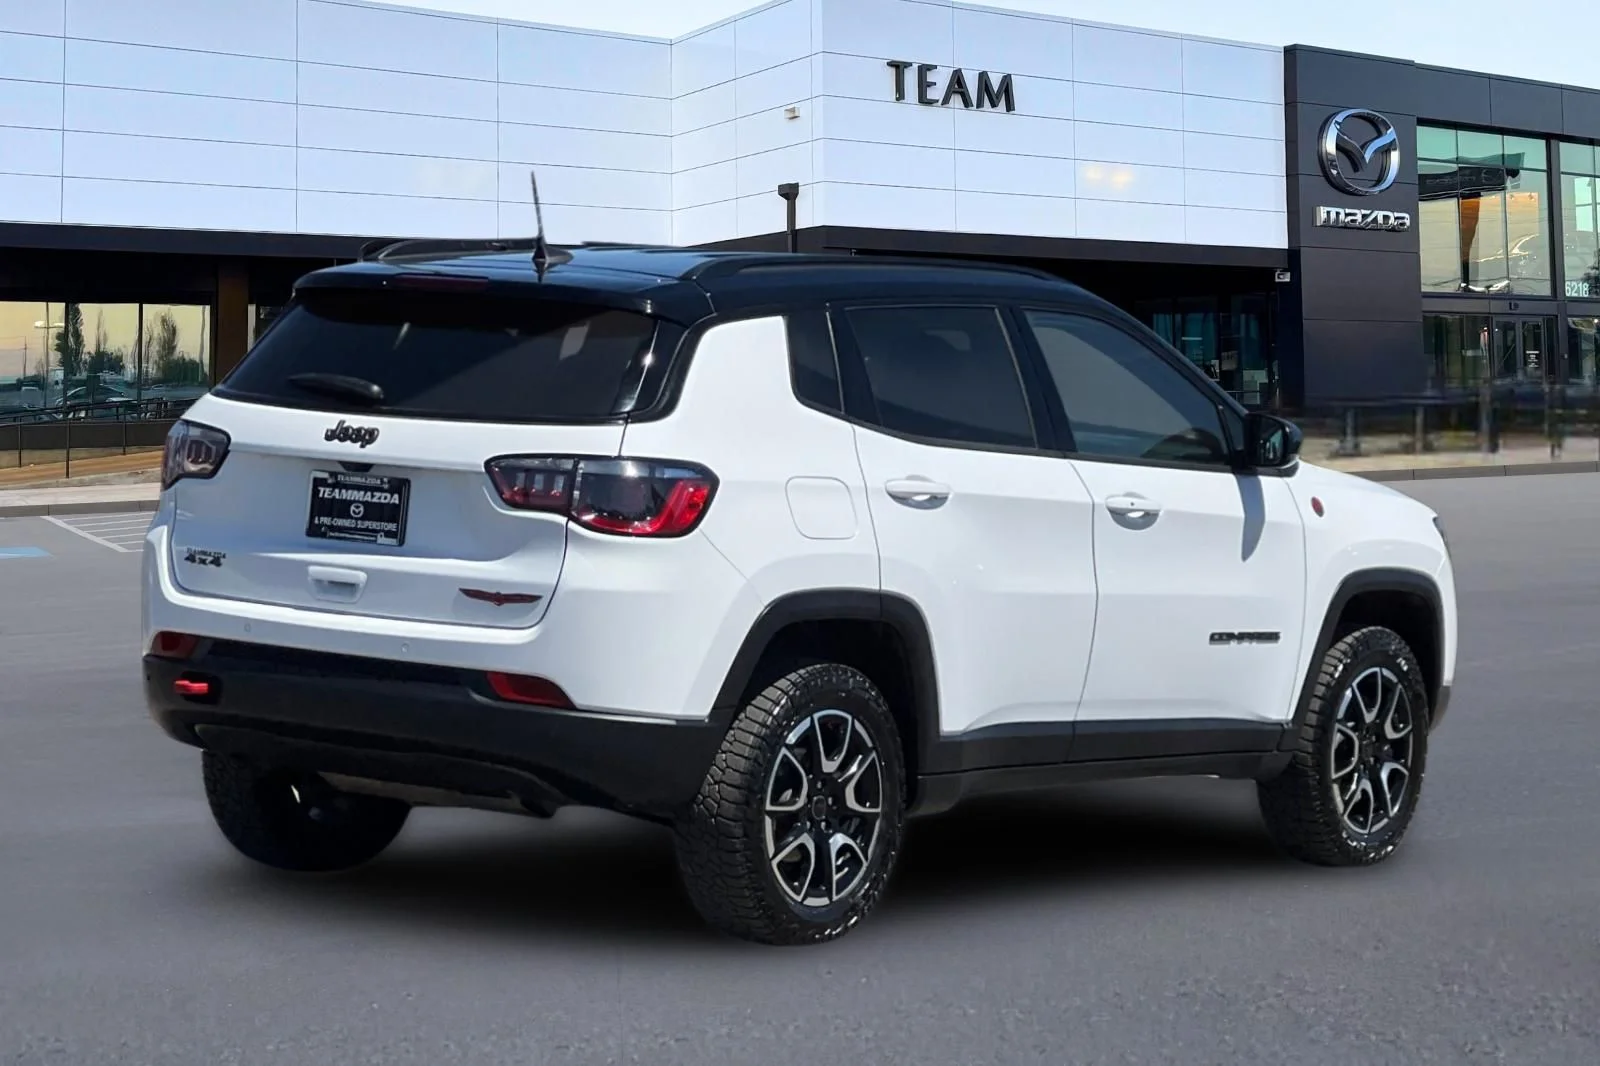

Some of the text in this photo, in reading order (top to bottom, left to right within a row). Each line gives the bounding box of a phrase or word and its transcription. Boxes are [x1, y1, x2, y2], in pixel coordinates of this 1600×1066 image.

[886, 60, 1016, 112] TEAM
[1565, 281, 1590, 297] 6218
[324, 419, 380, 448] Jeep
[318, 487, 400, 504] TEAMMAZDA
[319, 516, 356, 528] PRE-OWNED
[357, 520, 398, 532] SUPERSTORE
